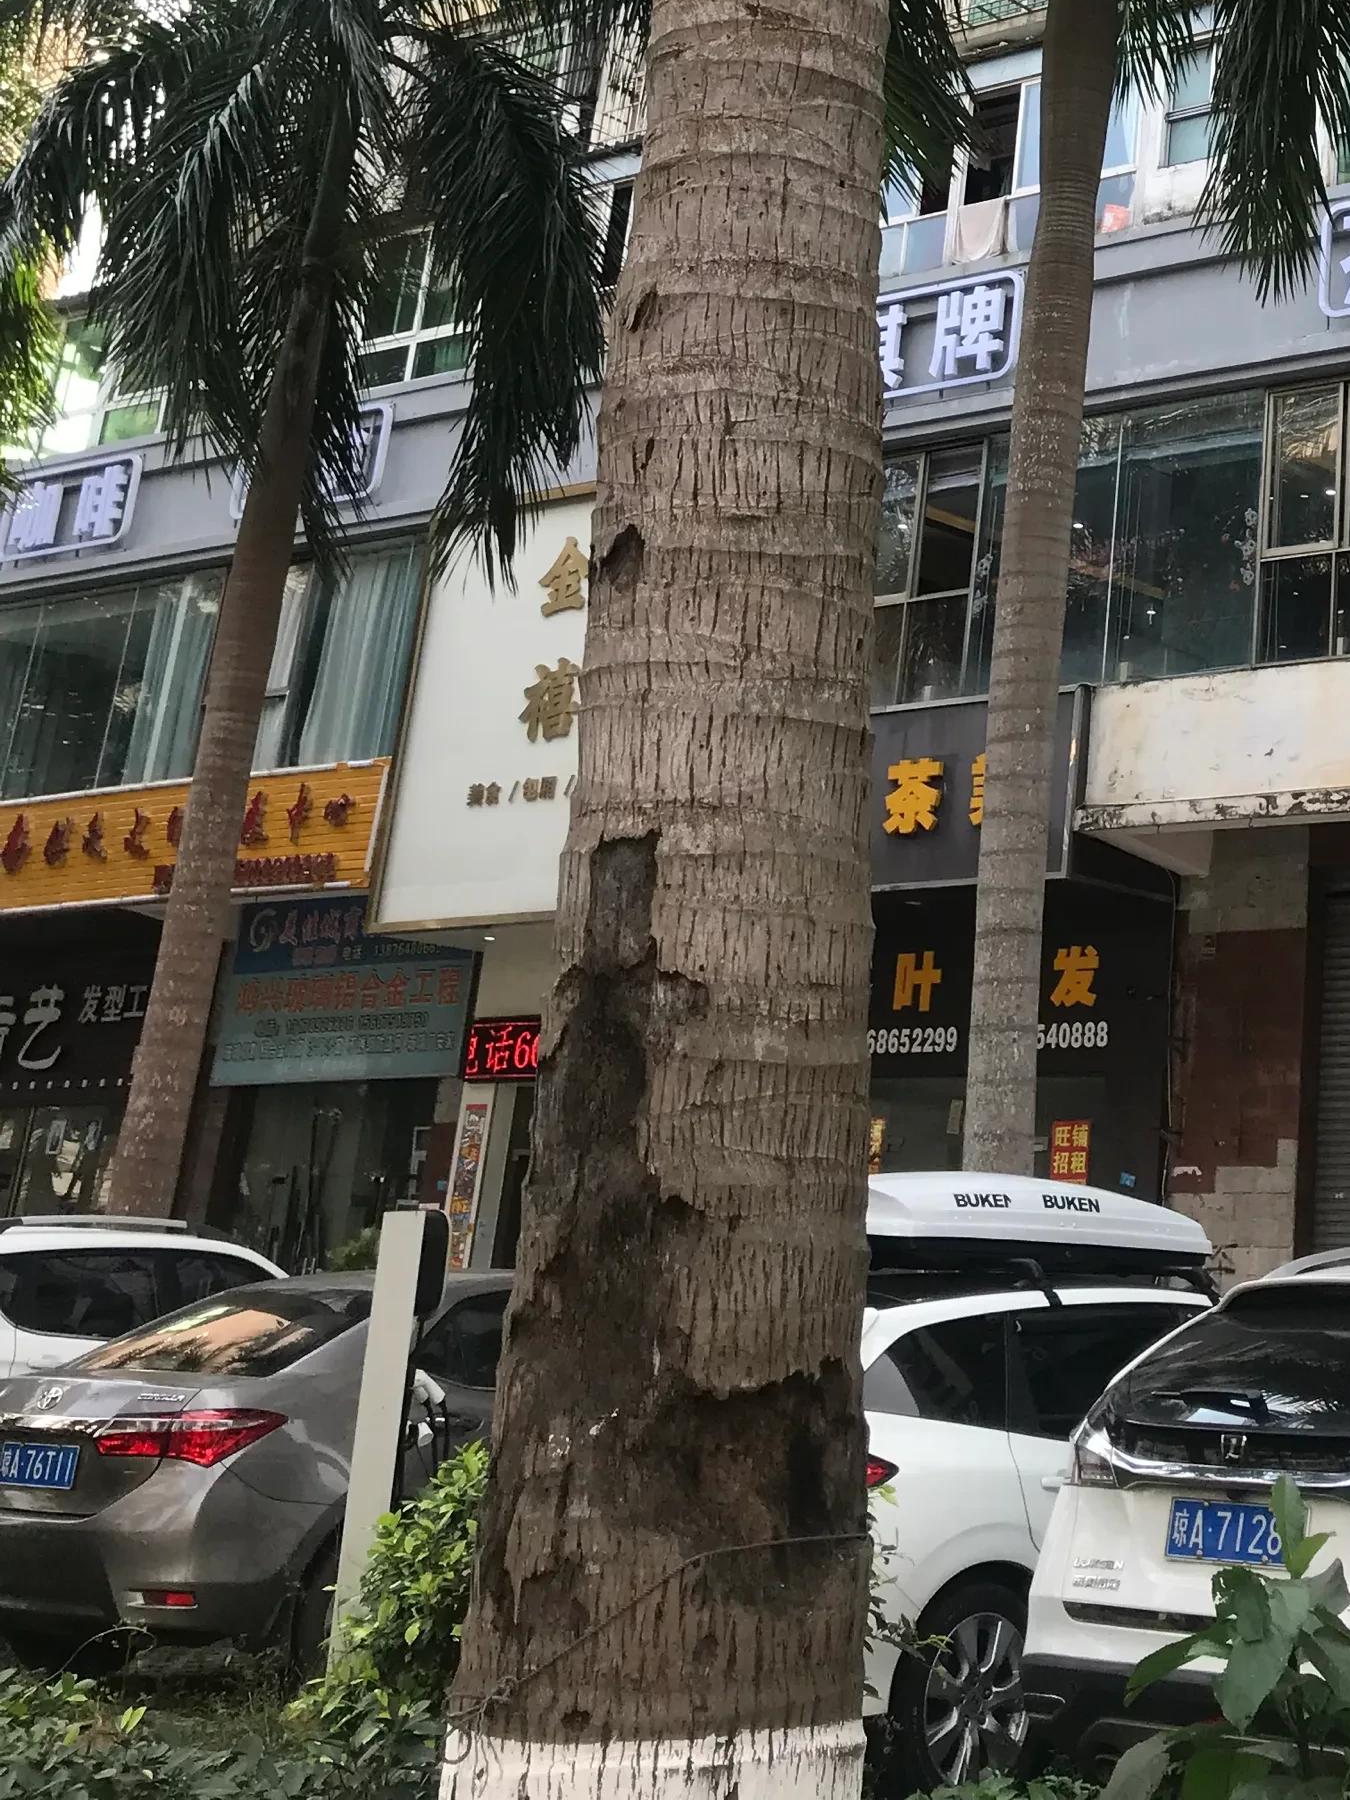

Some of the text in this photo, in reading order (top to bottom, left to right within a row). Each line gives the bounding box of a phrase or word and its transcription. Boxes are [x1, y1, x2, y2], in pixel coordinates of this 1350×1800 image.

[1054, 1123, 1090, 1148] 旺铺
[1053, 1150, 1087, 1175] 招租
[1042, 1194, 1101, 1214] BUKEN
